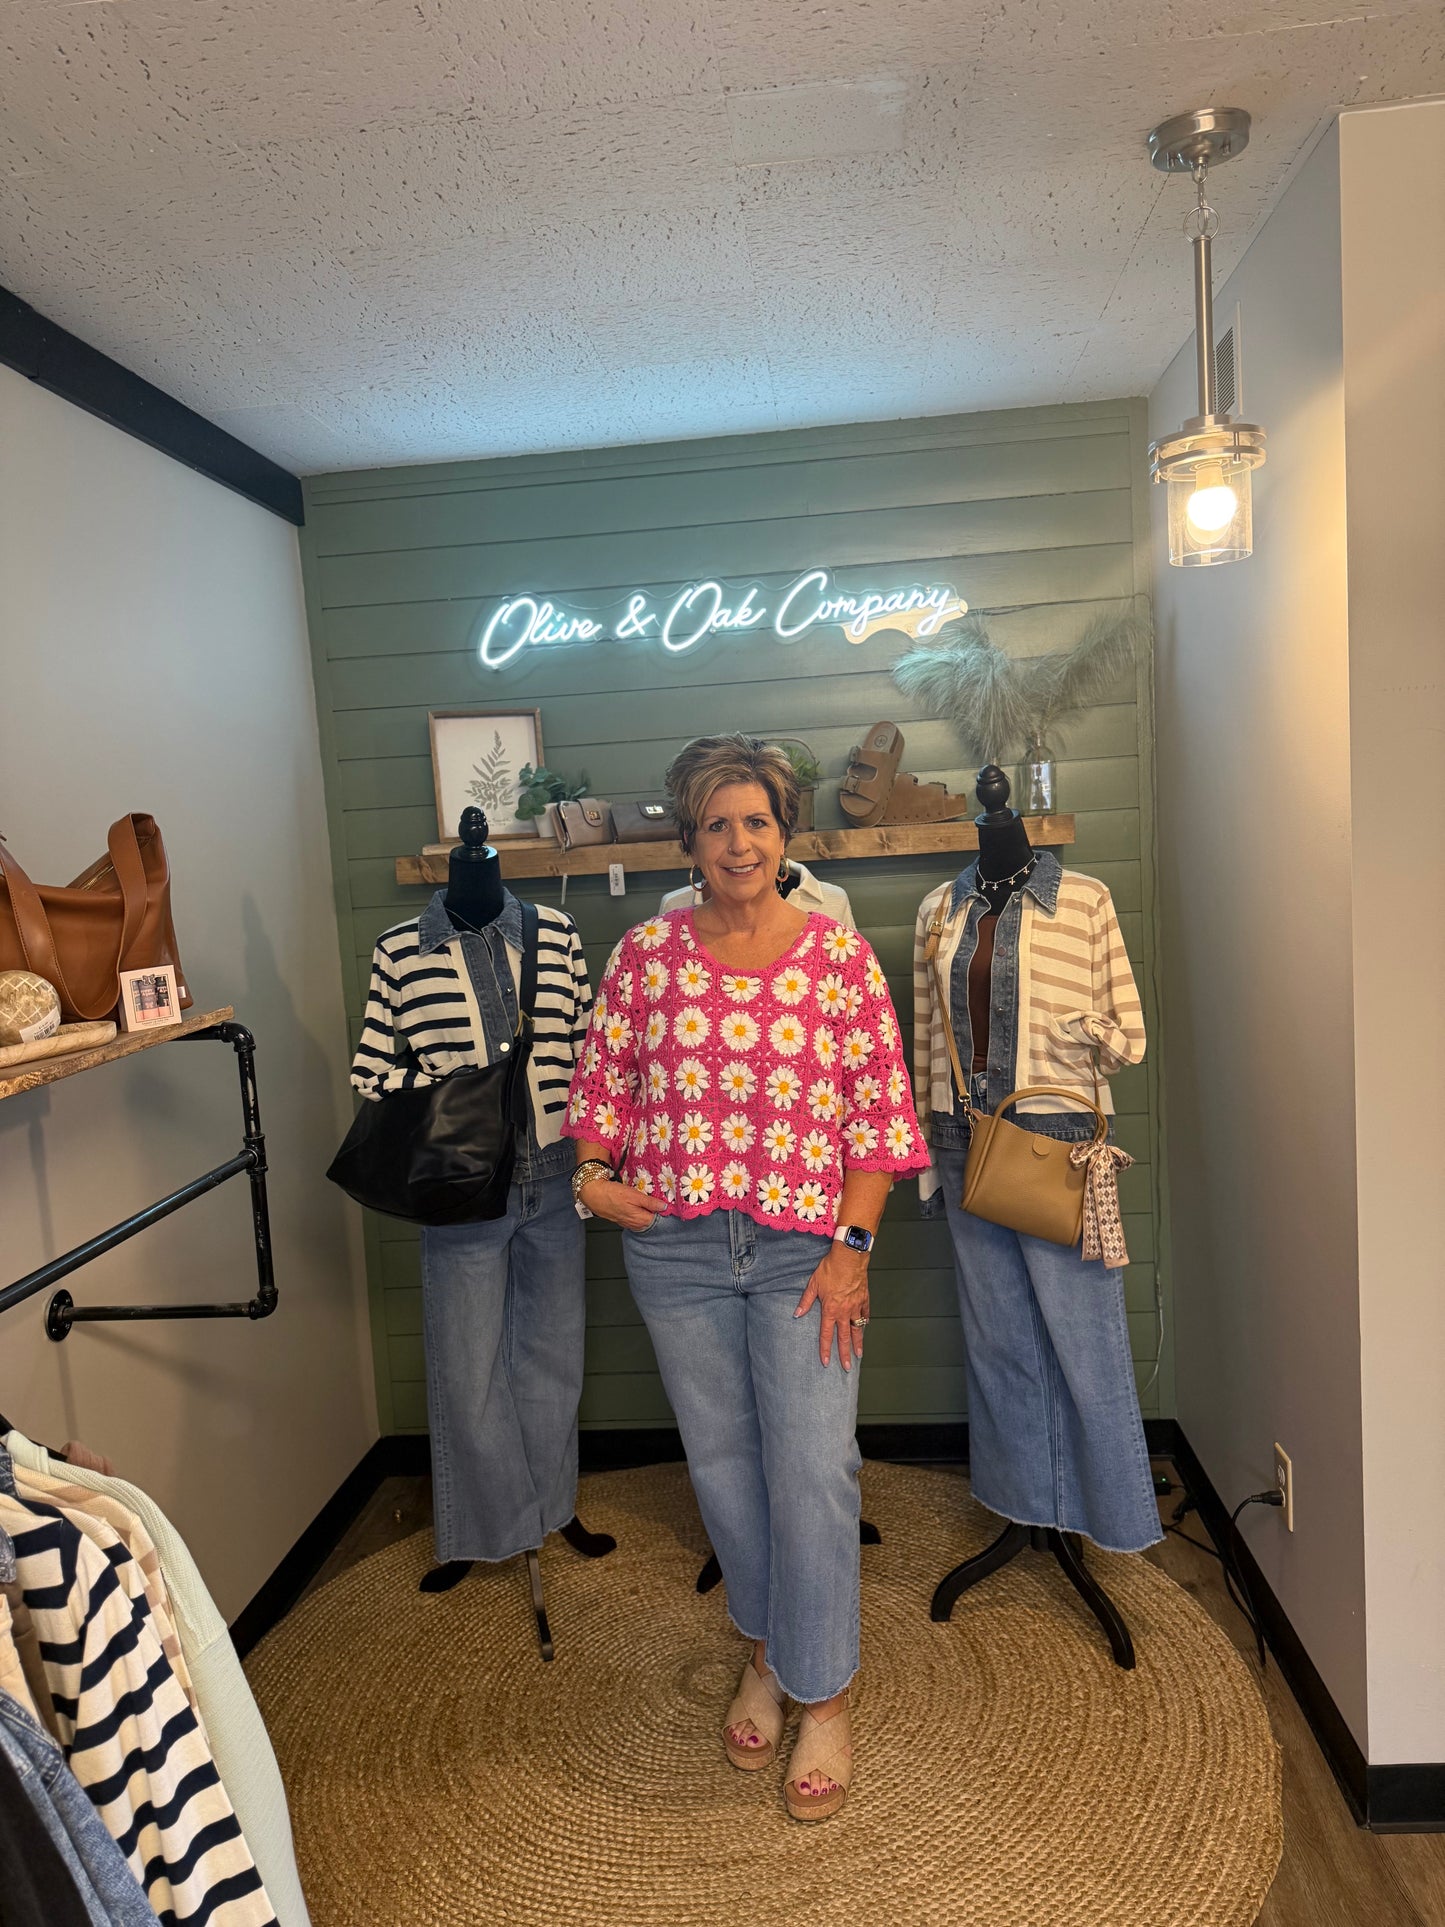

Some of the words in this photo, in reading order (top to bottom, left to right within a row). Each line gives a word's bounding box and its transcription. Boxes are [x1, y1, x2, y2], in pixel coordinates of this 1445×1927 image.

[480, 597, 603, 667] Olive
[616, 594, 657, 637] &
[662, 581, 767, 652] Oak
[775, 570, 963, 638] Company
